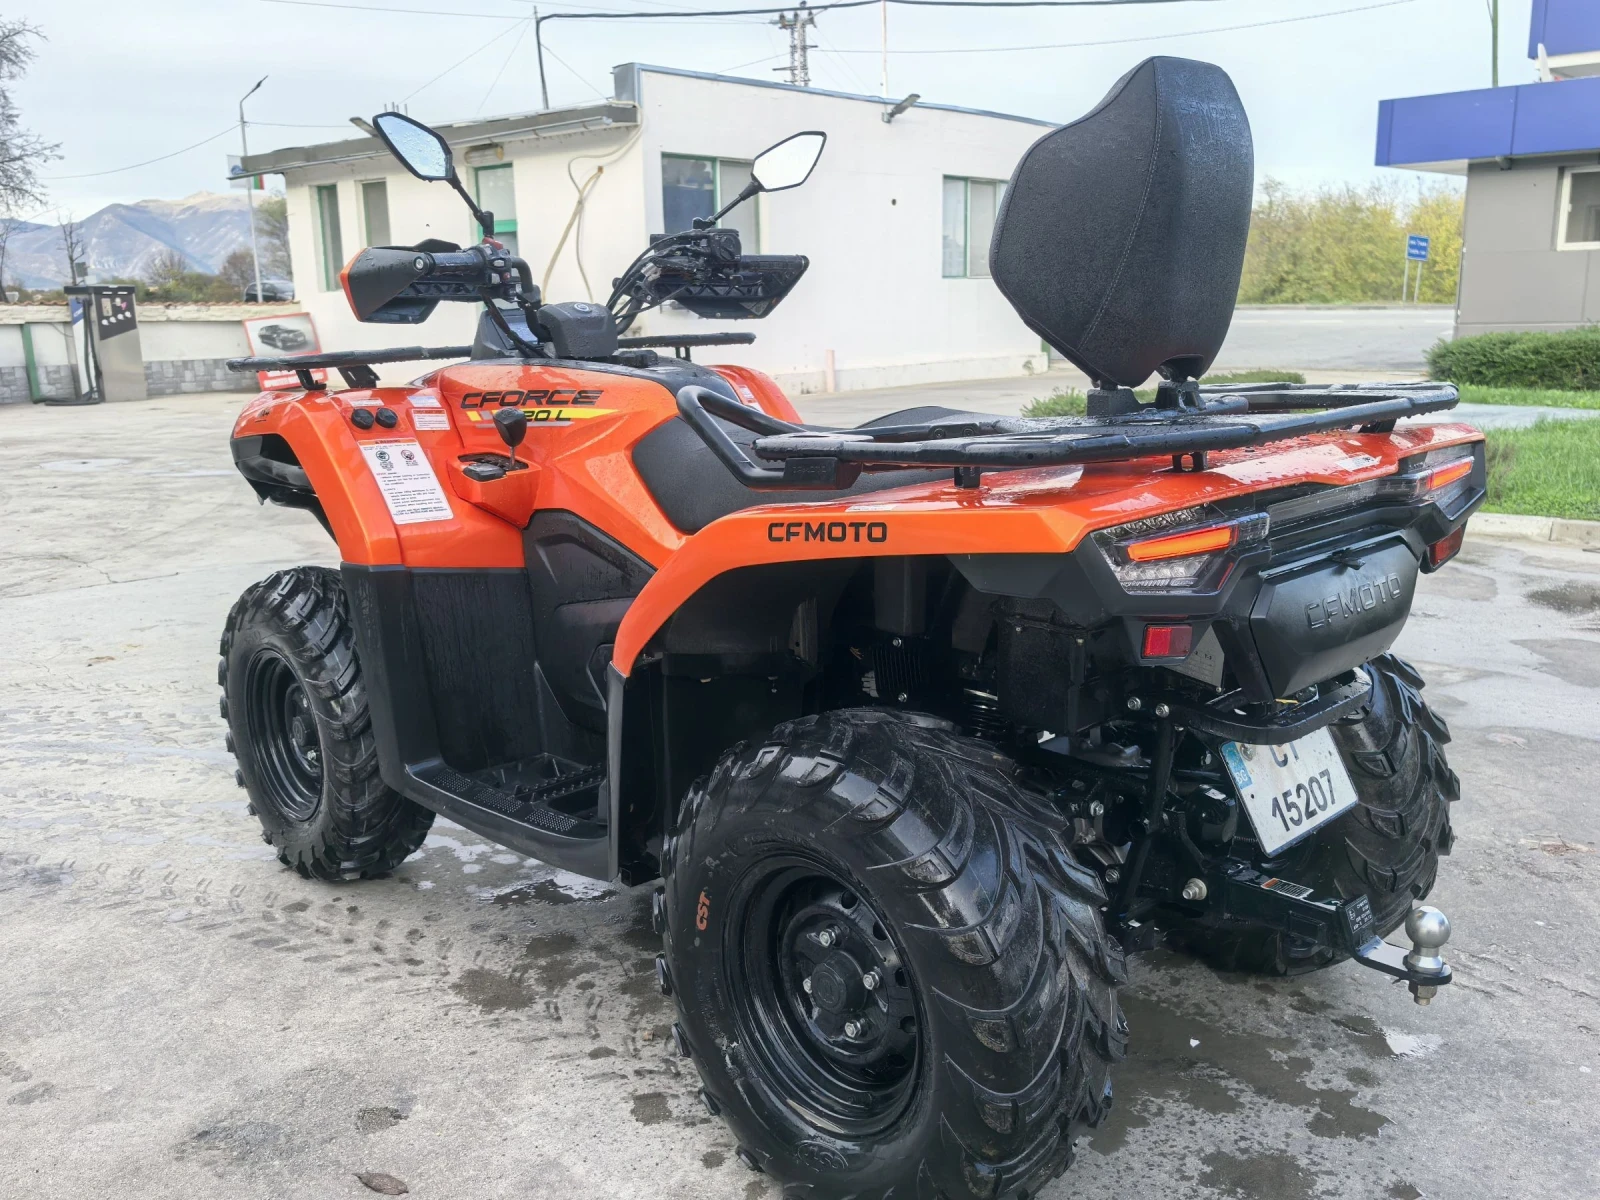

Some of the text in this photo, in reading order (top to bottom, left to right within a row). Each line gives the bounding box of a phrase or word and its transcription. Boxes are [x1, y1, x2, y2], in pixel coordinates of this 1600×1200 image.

[460, 389, 604, 409] CFORCE
[523, 409, 571, 422] 20 L
[768, 522, 887, 542] CFMOTO
[1304, 572, 1400, 629] CFMOTO
[1271, 768, 1336, 832] 15207
[696, 890, 710, 931] CST
